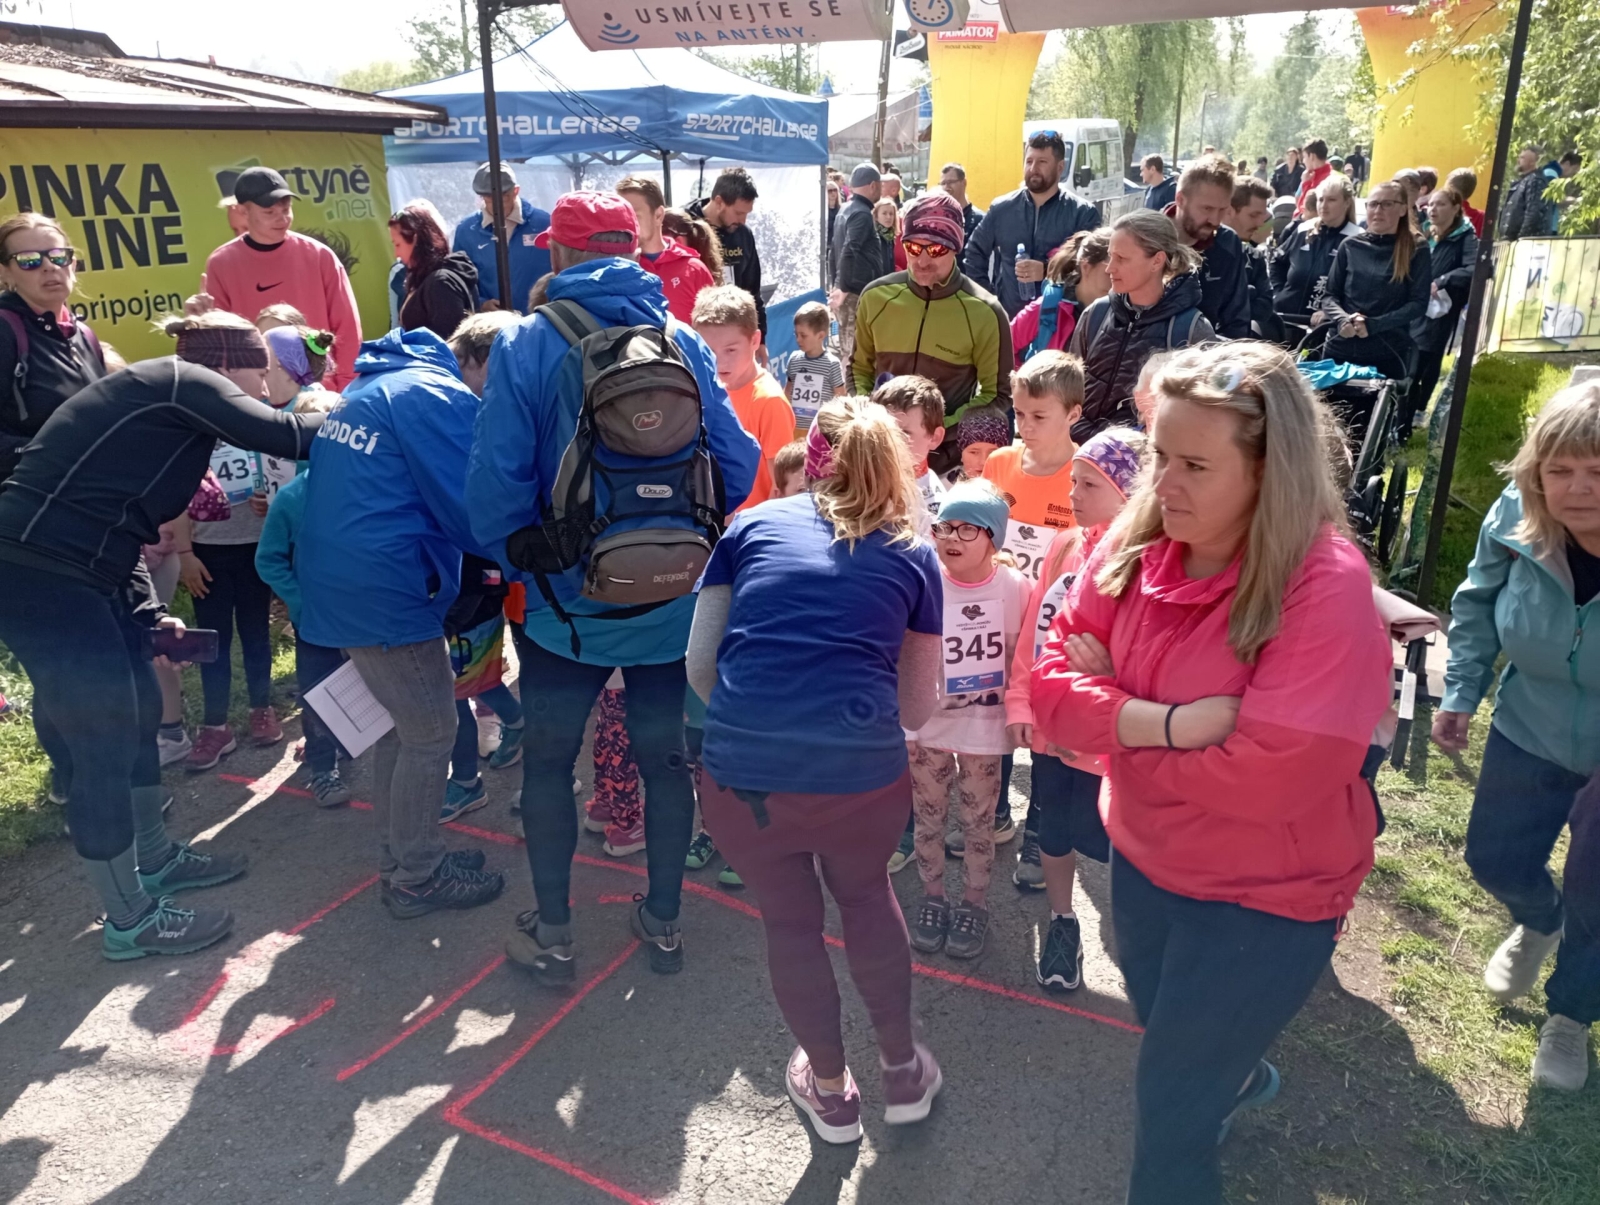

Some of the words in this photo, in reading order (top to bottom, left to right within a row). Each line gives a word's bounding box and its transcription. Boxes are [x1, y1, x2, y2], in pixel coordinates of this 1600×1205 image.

[634, 1, 793, 24] USMÍVEJTE
[809, 0, 842, 17] SE
[675, 31, 708, 42] NA
[0, 163, 180, 218] INKA
[792, 387, 821, 404] 349
[653, 571, 689, 584] DEFENDER
[945, 631, 1003, 664] 345
